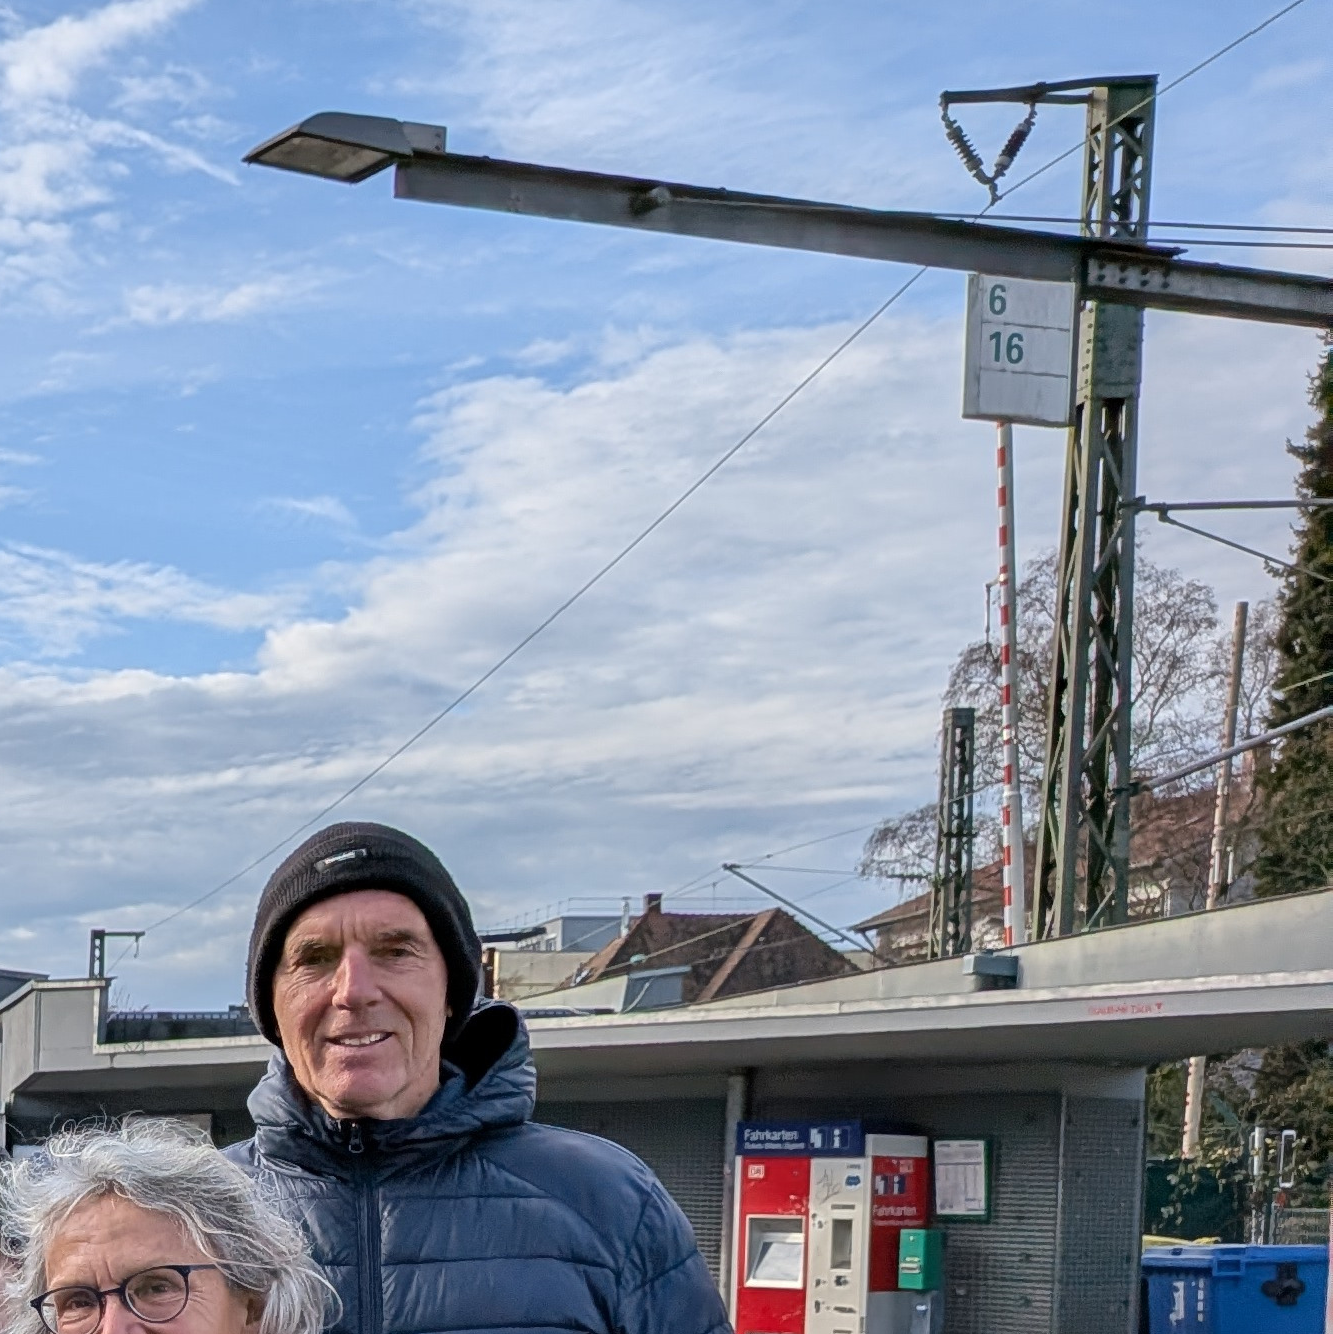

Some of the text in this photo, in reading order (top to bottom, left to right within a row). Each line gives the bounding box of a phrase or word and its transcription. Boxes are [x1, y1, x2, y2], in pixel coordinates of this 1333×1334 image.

[989, 284, 1007, 316] 6
[989, 331, 1024, 364] 16
[744, 1128, 799, 1141] Fahrkarten
